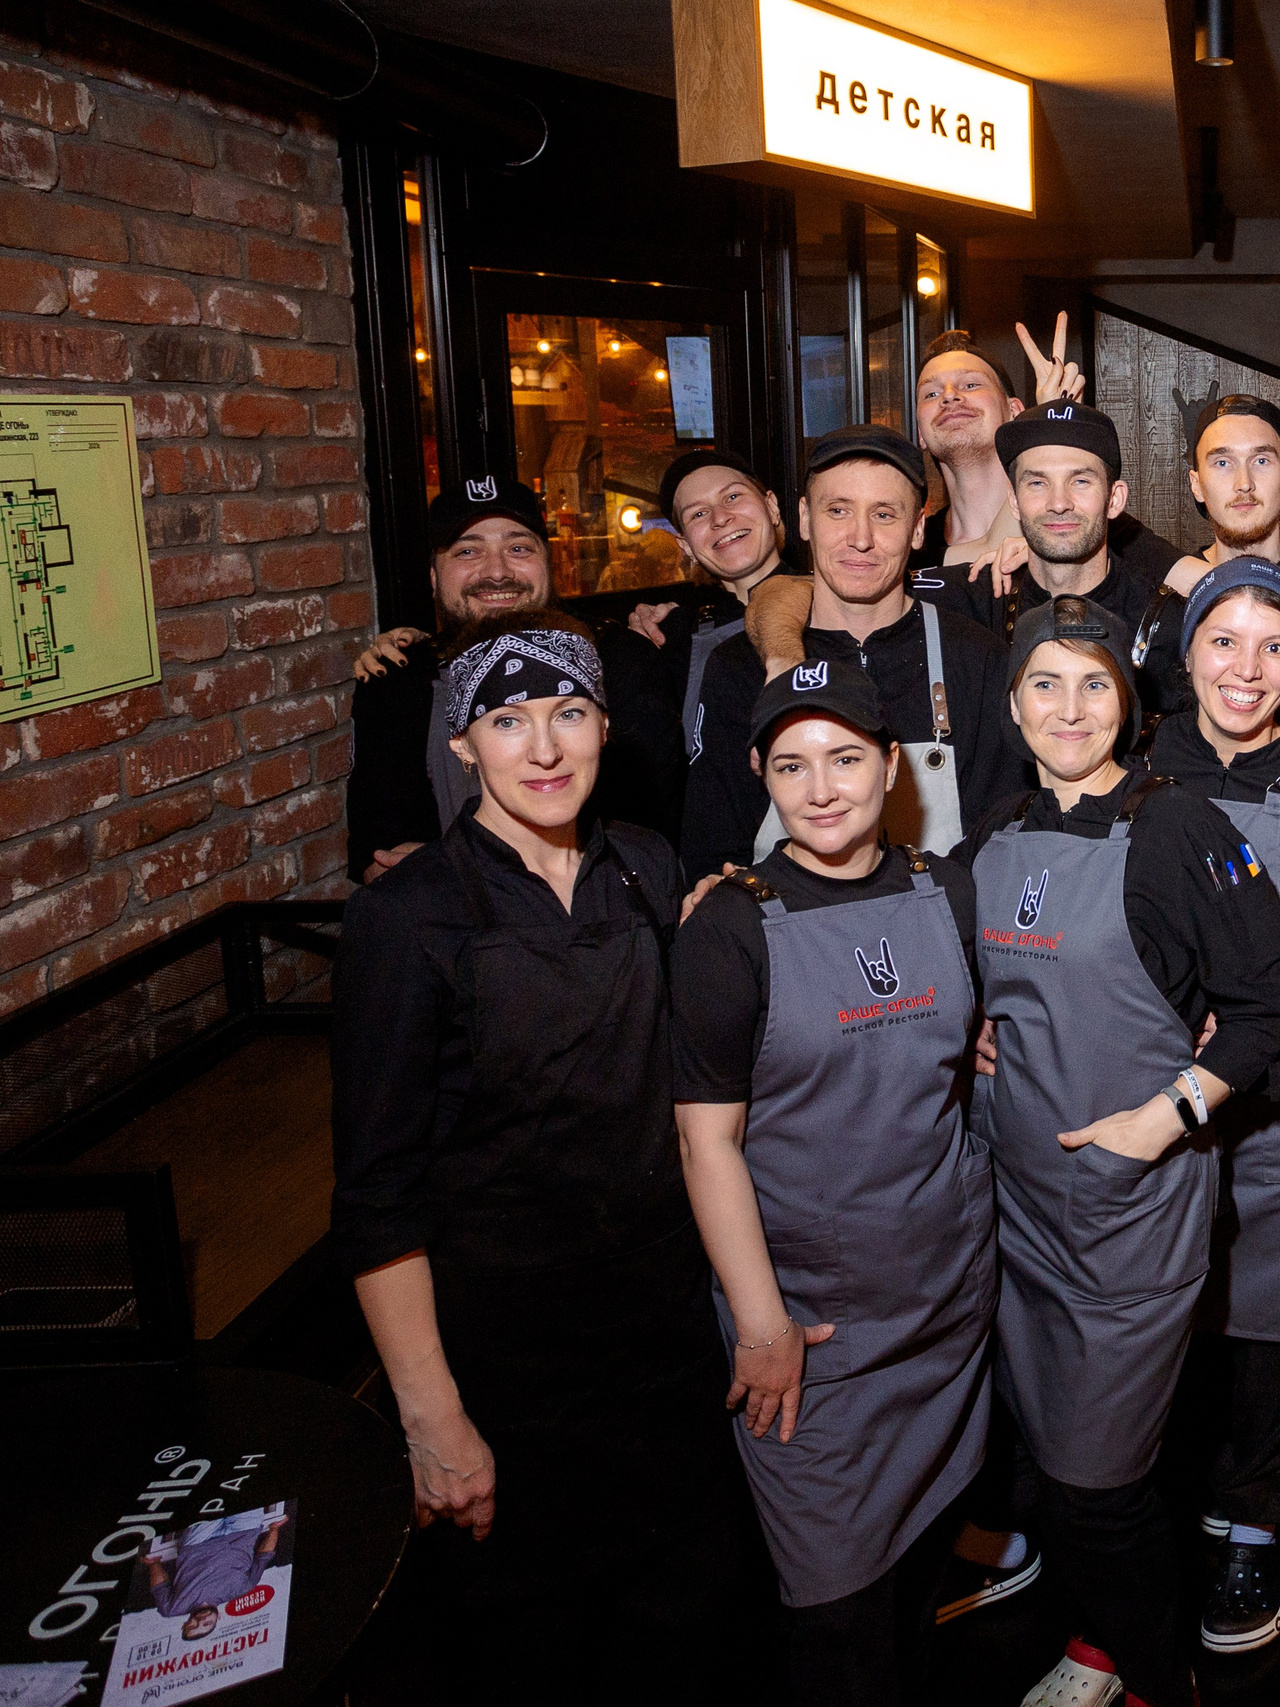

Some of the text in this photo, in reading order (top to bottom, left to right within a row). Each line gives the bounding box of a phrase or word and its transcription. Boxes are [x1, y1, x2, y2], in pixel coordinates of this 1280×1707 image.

[815, 70, 996, 151] детская
[29, 432, 40, 441] 223
[982, 927, 1058, 950] ВАШЕ ОГОНЬ
[1012, 950, 1059, 963] РЕСТОРАН
[838, 994, 934, 1024] ВАШЕ ОГОНЬ
[888, 1009, 939, 1027] РЕСТОРАН
[122, 1628, 269, 1689] ГАСТРОУЖИН
